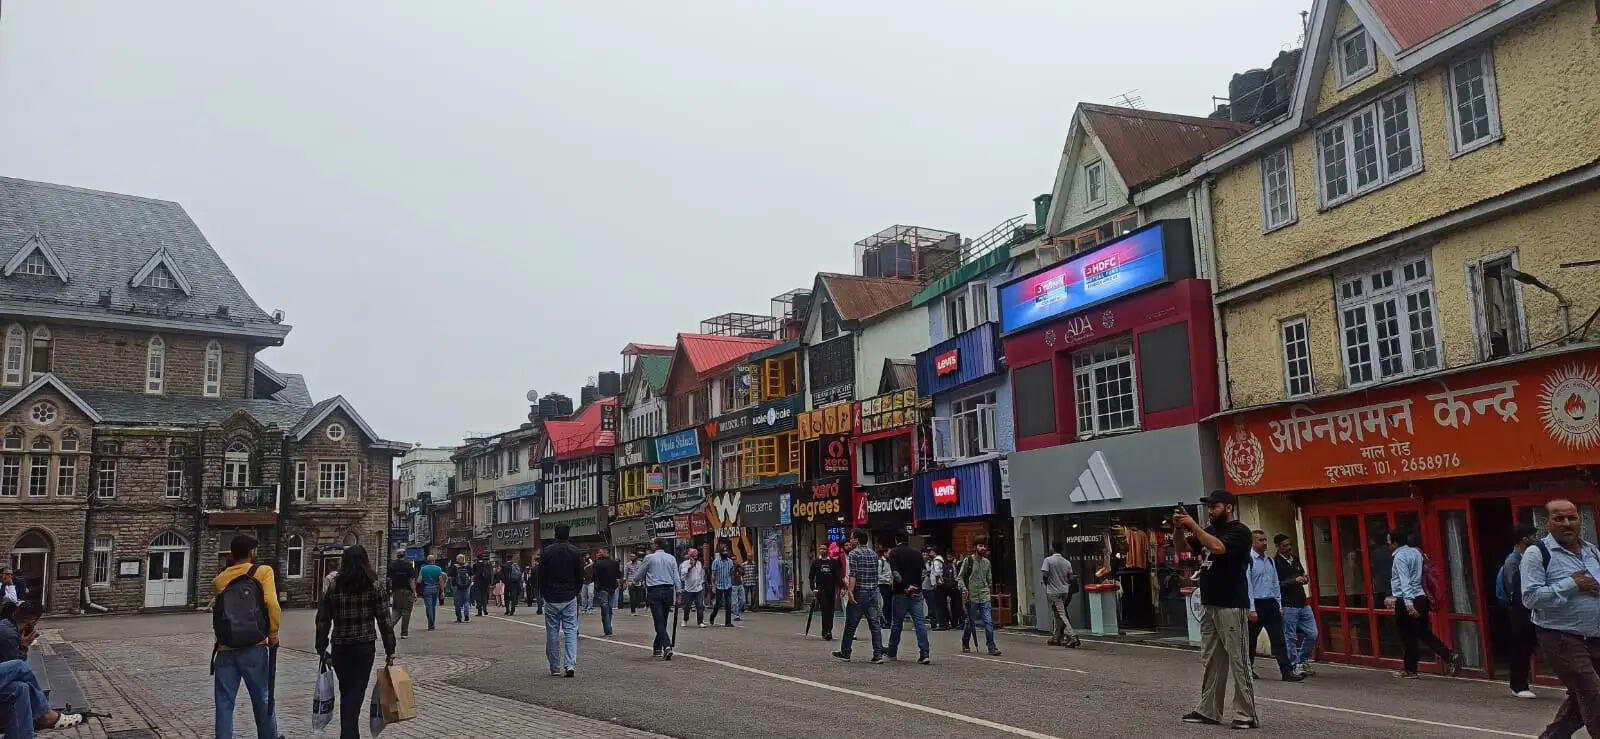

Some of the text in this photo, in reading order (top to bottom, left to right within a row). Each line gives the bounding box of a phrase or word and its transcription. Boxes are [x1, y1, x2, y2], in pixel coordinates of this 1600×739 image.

[1092, 256, 1117, 273] HDFC
[1065, 315, 1094, 340] ADA
[1269, 379, 1520, 453] अग्निशमन केन्द्र
[1360, 437, 1411, 460] माल रोड
[1402, 453, 1460, 473] 2658976
[812, 482, 839, 499] xero
[745, 502, 773, 513] madame
[793, 499, 840, 521] degrees
[866, 499, 893, 513] Hideout
[496, 527, 529, 539] OCTAVE
